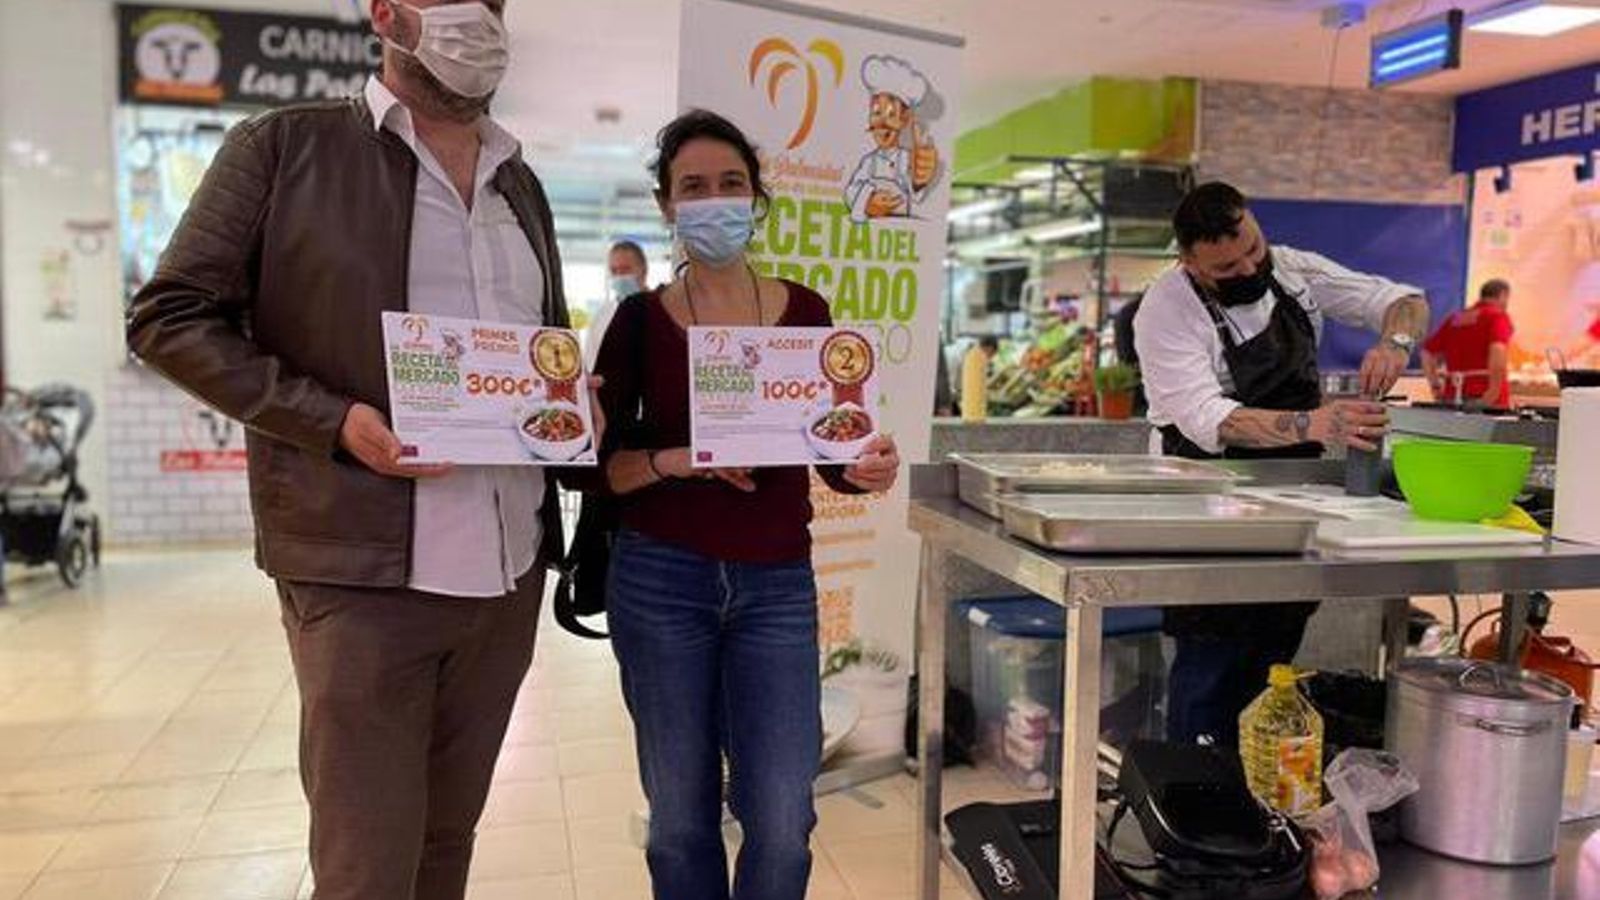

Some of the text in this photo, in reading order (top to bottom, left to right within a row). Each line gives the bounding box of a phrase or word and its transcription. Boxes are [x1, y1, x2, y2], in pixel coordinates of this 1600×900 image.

[878, 228, 920, 262] DEL
[839, 345, 855, 370] 2
[393, 366, 460, 387] MERCADO
